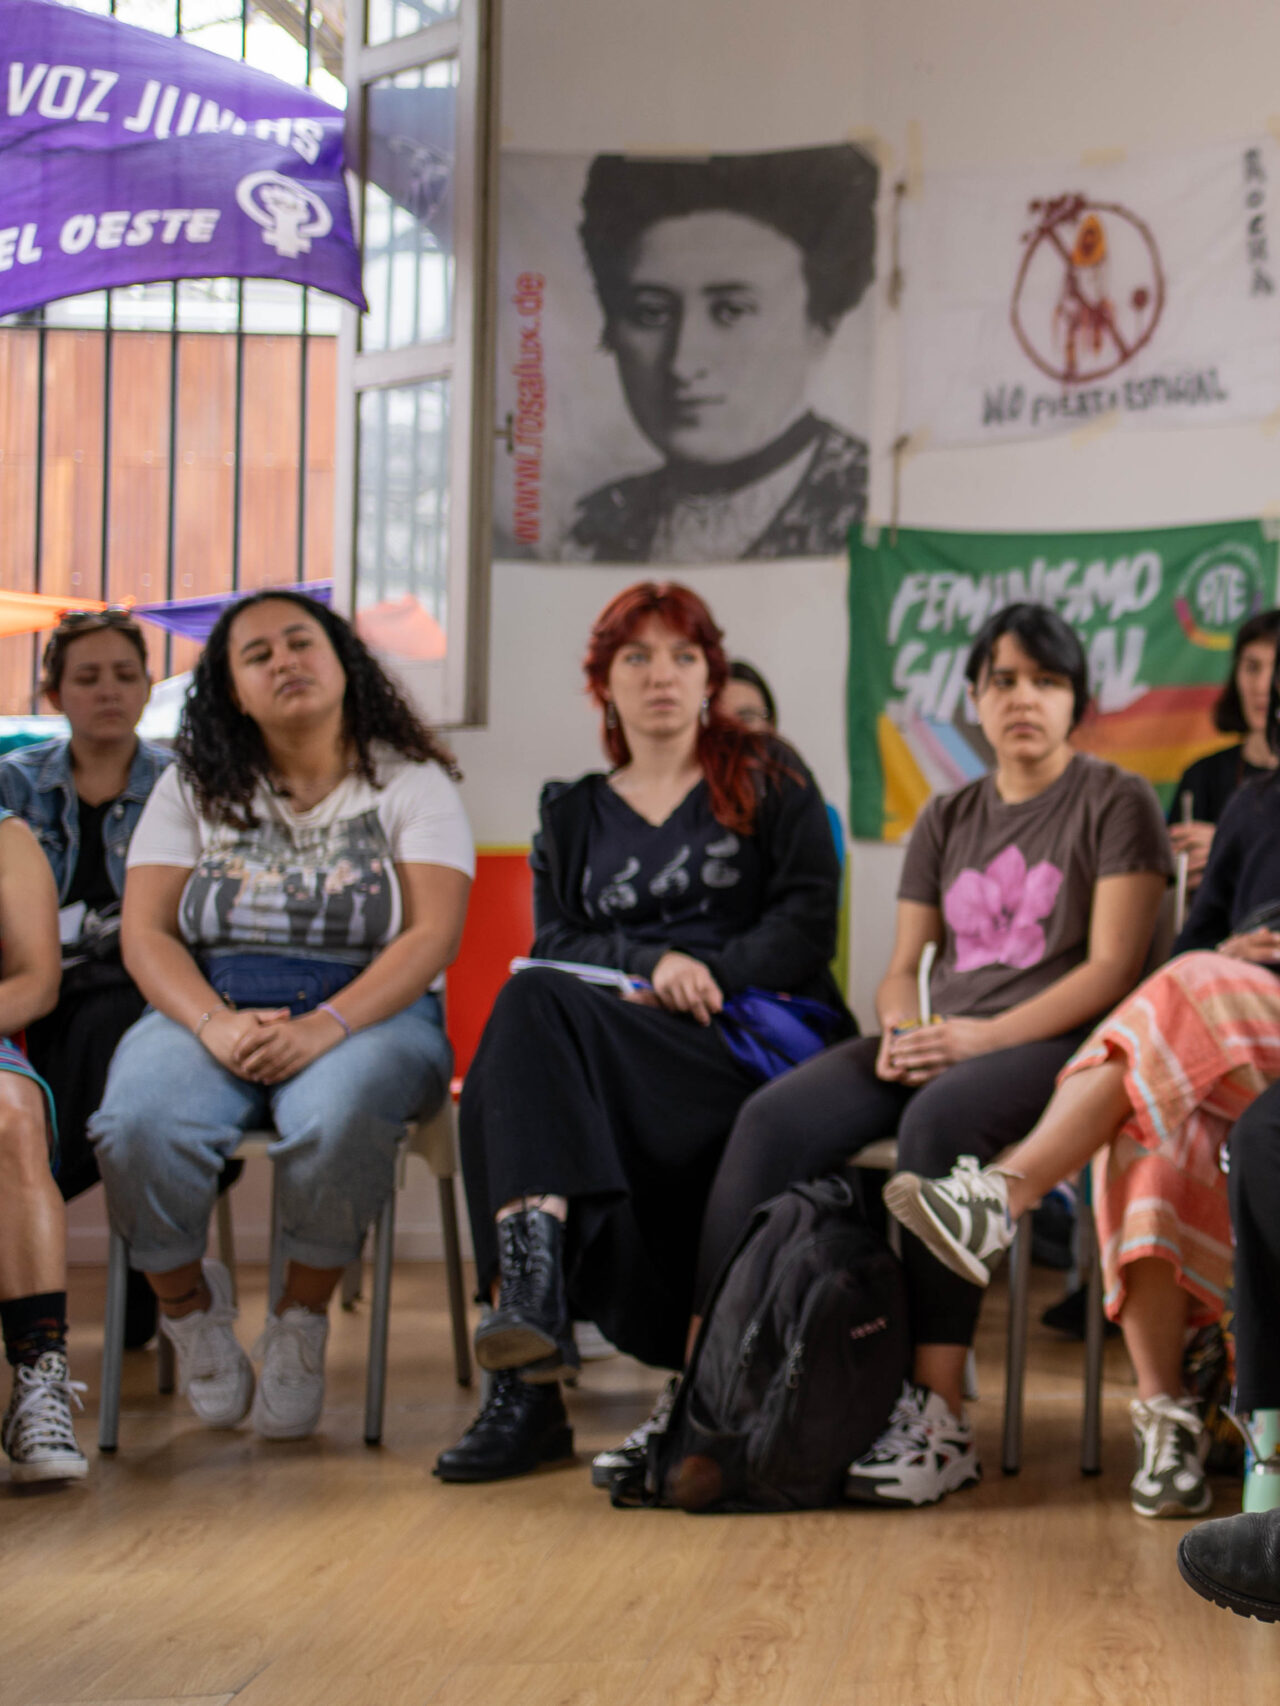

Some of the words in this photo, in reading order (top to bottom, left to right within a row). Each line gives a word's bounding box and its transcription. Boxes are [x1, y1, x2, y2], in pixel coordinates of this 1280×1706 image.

[8, 62, 118, 123] VOZ
[123, 79, 324, 165] JUNAS
[60, 209, 220, 254] OESTE
[512, 271, 546, 545] www.rosalux.de
[888, 549, 1162, 644] FEMINISMO
